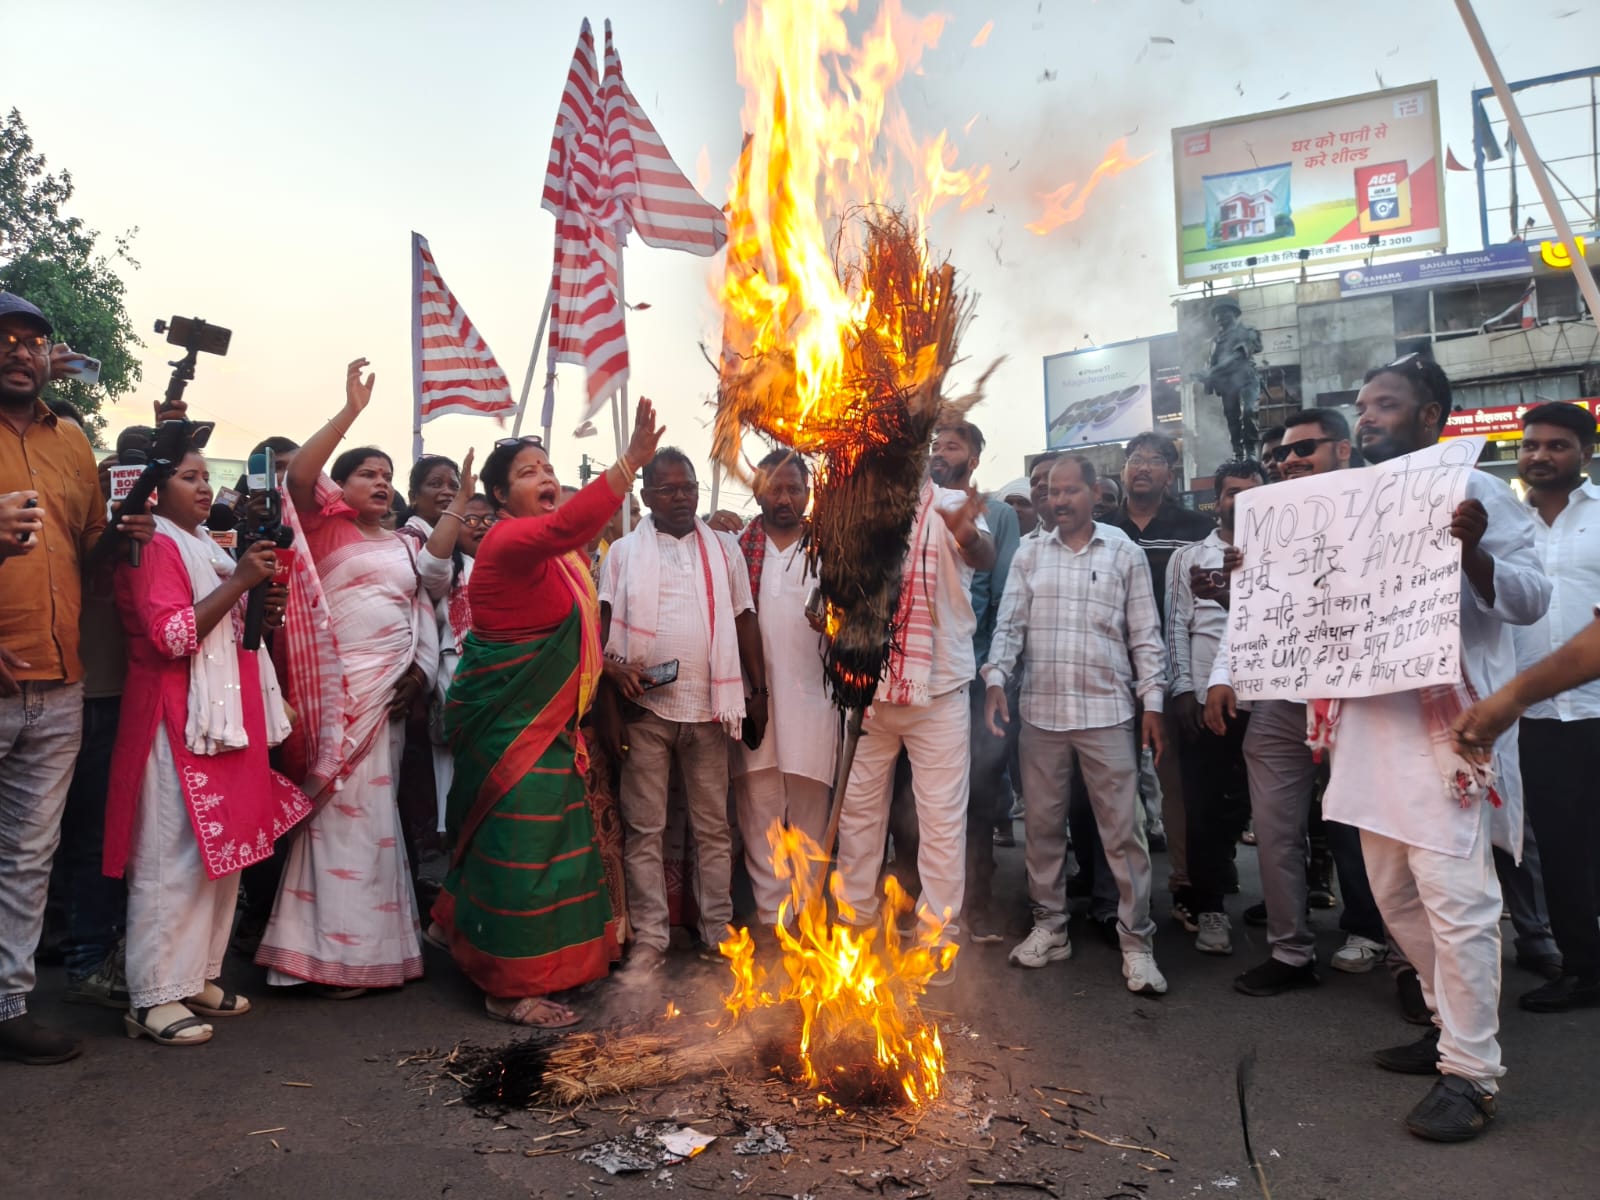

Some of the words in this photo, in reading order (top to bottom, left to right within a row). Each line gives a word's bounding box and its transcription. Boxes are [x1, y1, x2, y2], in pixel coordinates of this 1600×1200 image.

[1291, 139, 1312, 152] घर
[1315, 131, 1336, 149] को
[1339, 125, 1371, 144] पानी
[1374, 122, 1388, 138] से
[1331, 146, 1370, 164] शील्ड
[1367, 172, 1397, 186] ACC
[1389, 235, 1413, 246] 3010
[1419, 258, 1461, 271] SAHARA
[1463, 254, 1491, 266] INDIA
[1363, 272, 1401, 283] SAHARA
[1475, 409, 1512, 425] नैशनल
[113, 469, 142, 479] NEWS
[1288, 534, 1347, 578] और
[1360, 525, 1434, 577] AMIT
[1263, 592, 1300, 630] यदि
[1411, 564, 1431, 589] हमें
[1304, 619, 1360, 643] संविधान
[1272, 645, 1311, 668] UNO
